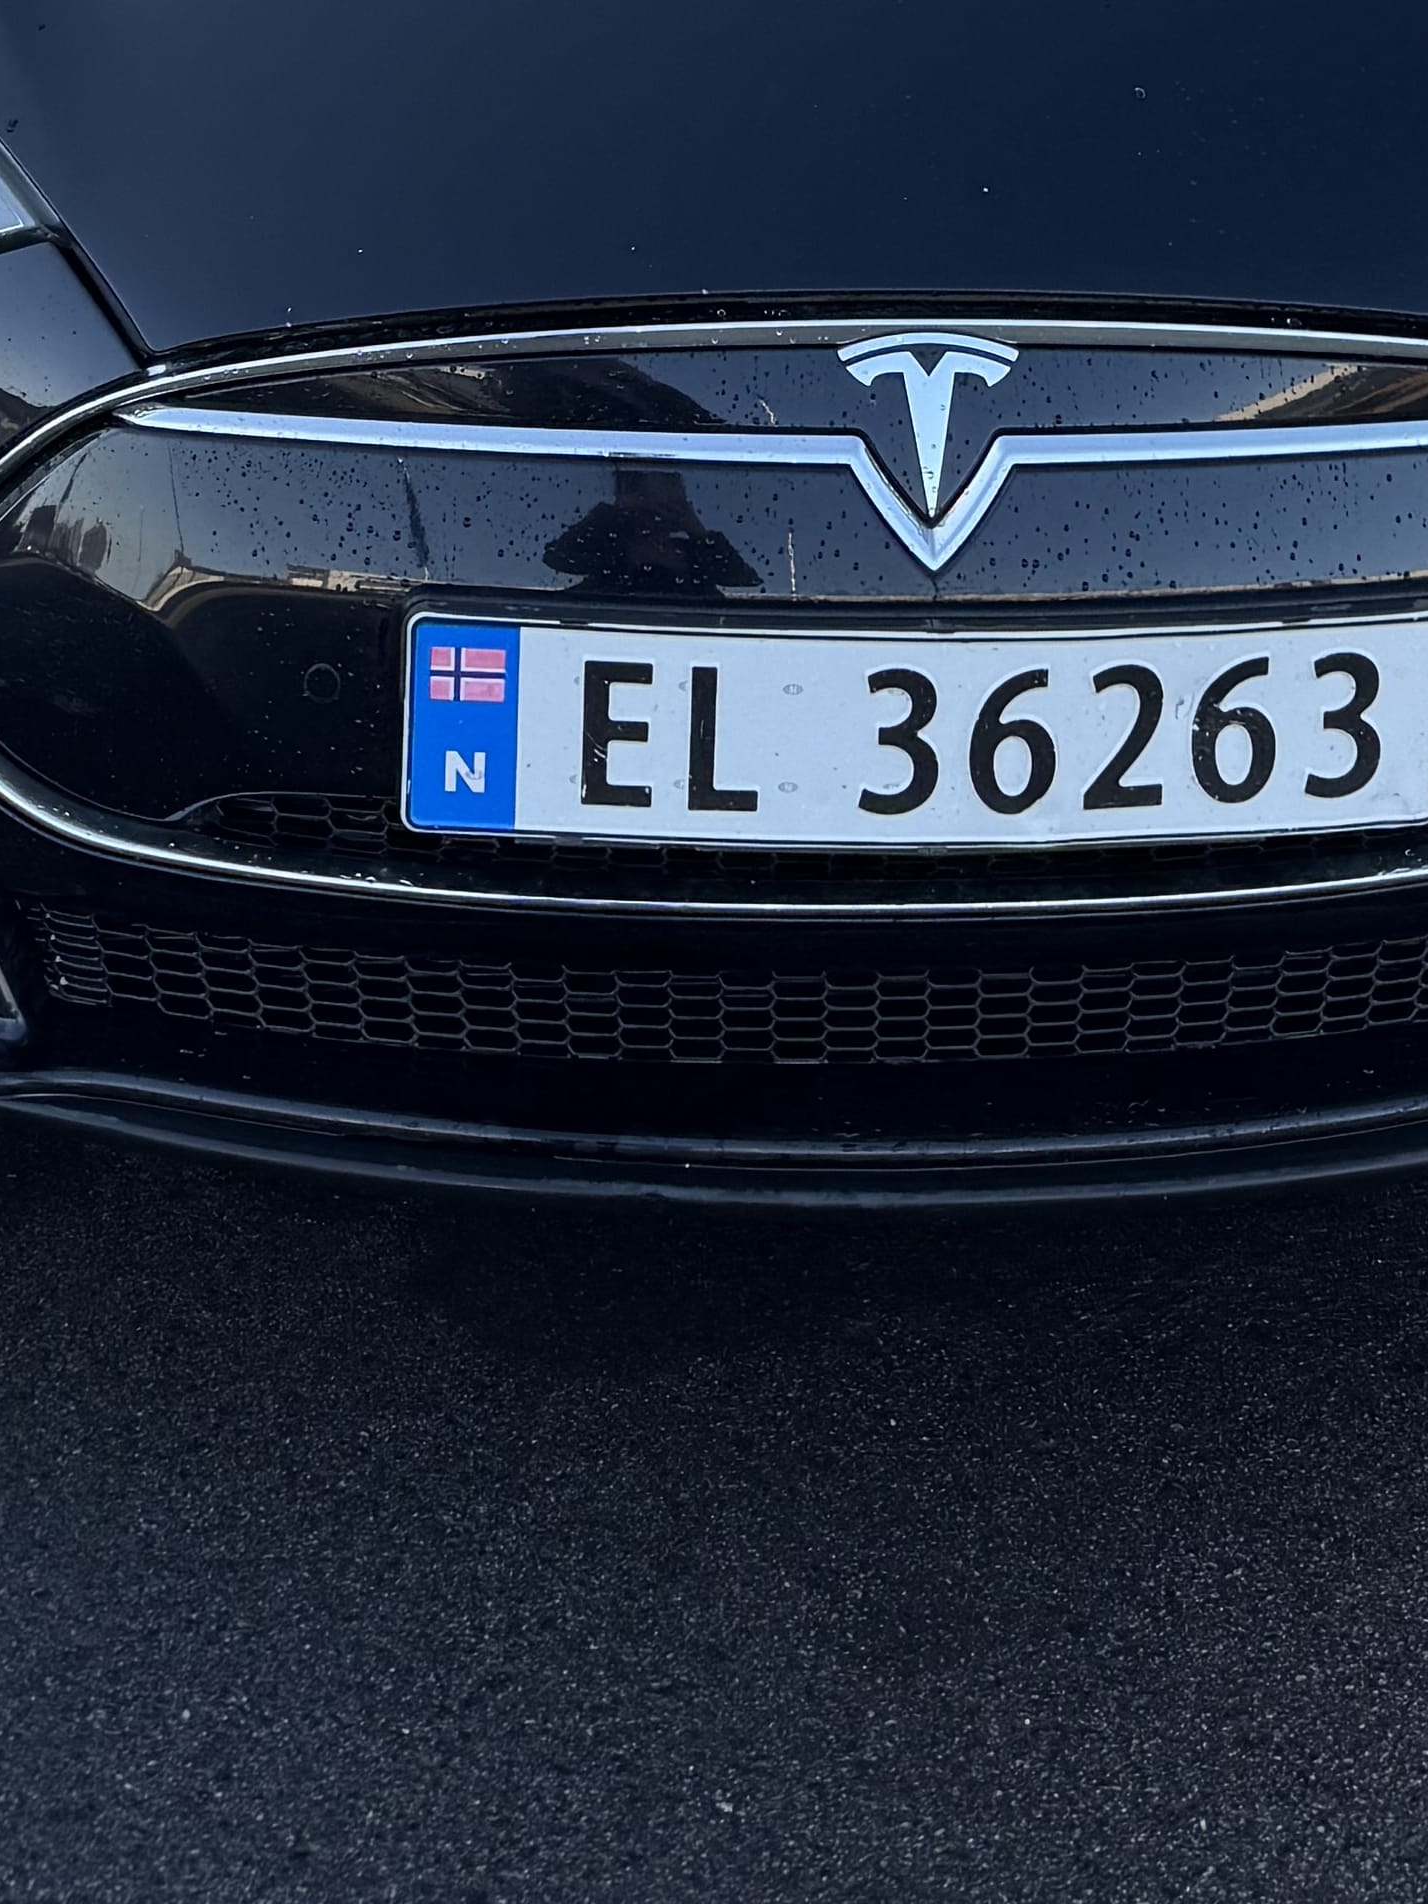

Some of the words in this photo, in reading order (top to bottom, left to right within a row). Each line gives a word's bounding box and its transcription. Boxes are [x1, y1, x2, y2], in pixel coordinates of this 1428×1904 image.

[445, 749, 487, 794] N
[580, 659, 760, 813] EL
[857, 650, 1381, 817] 36263
